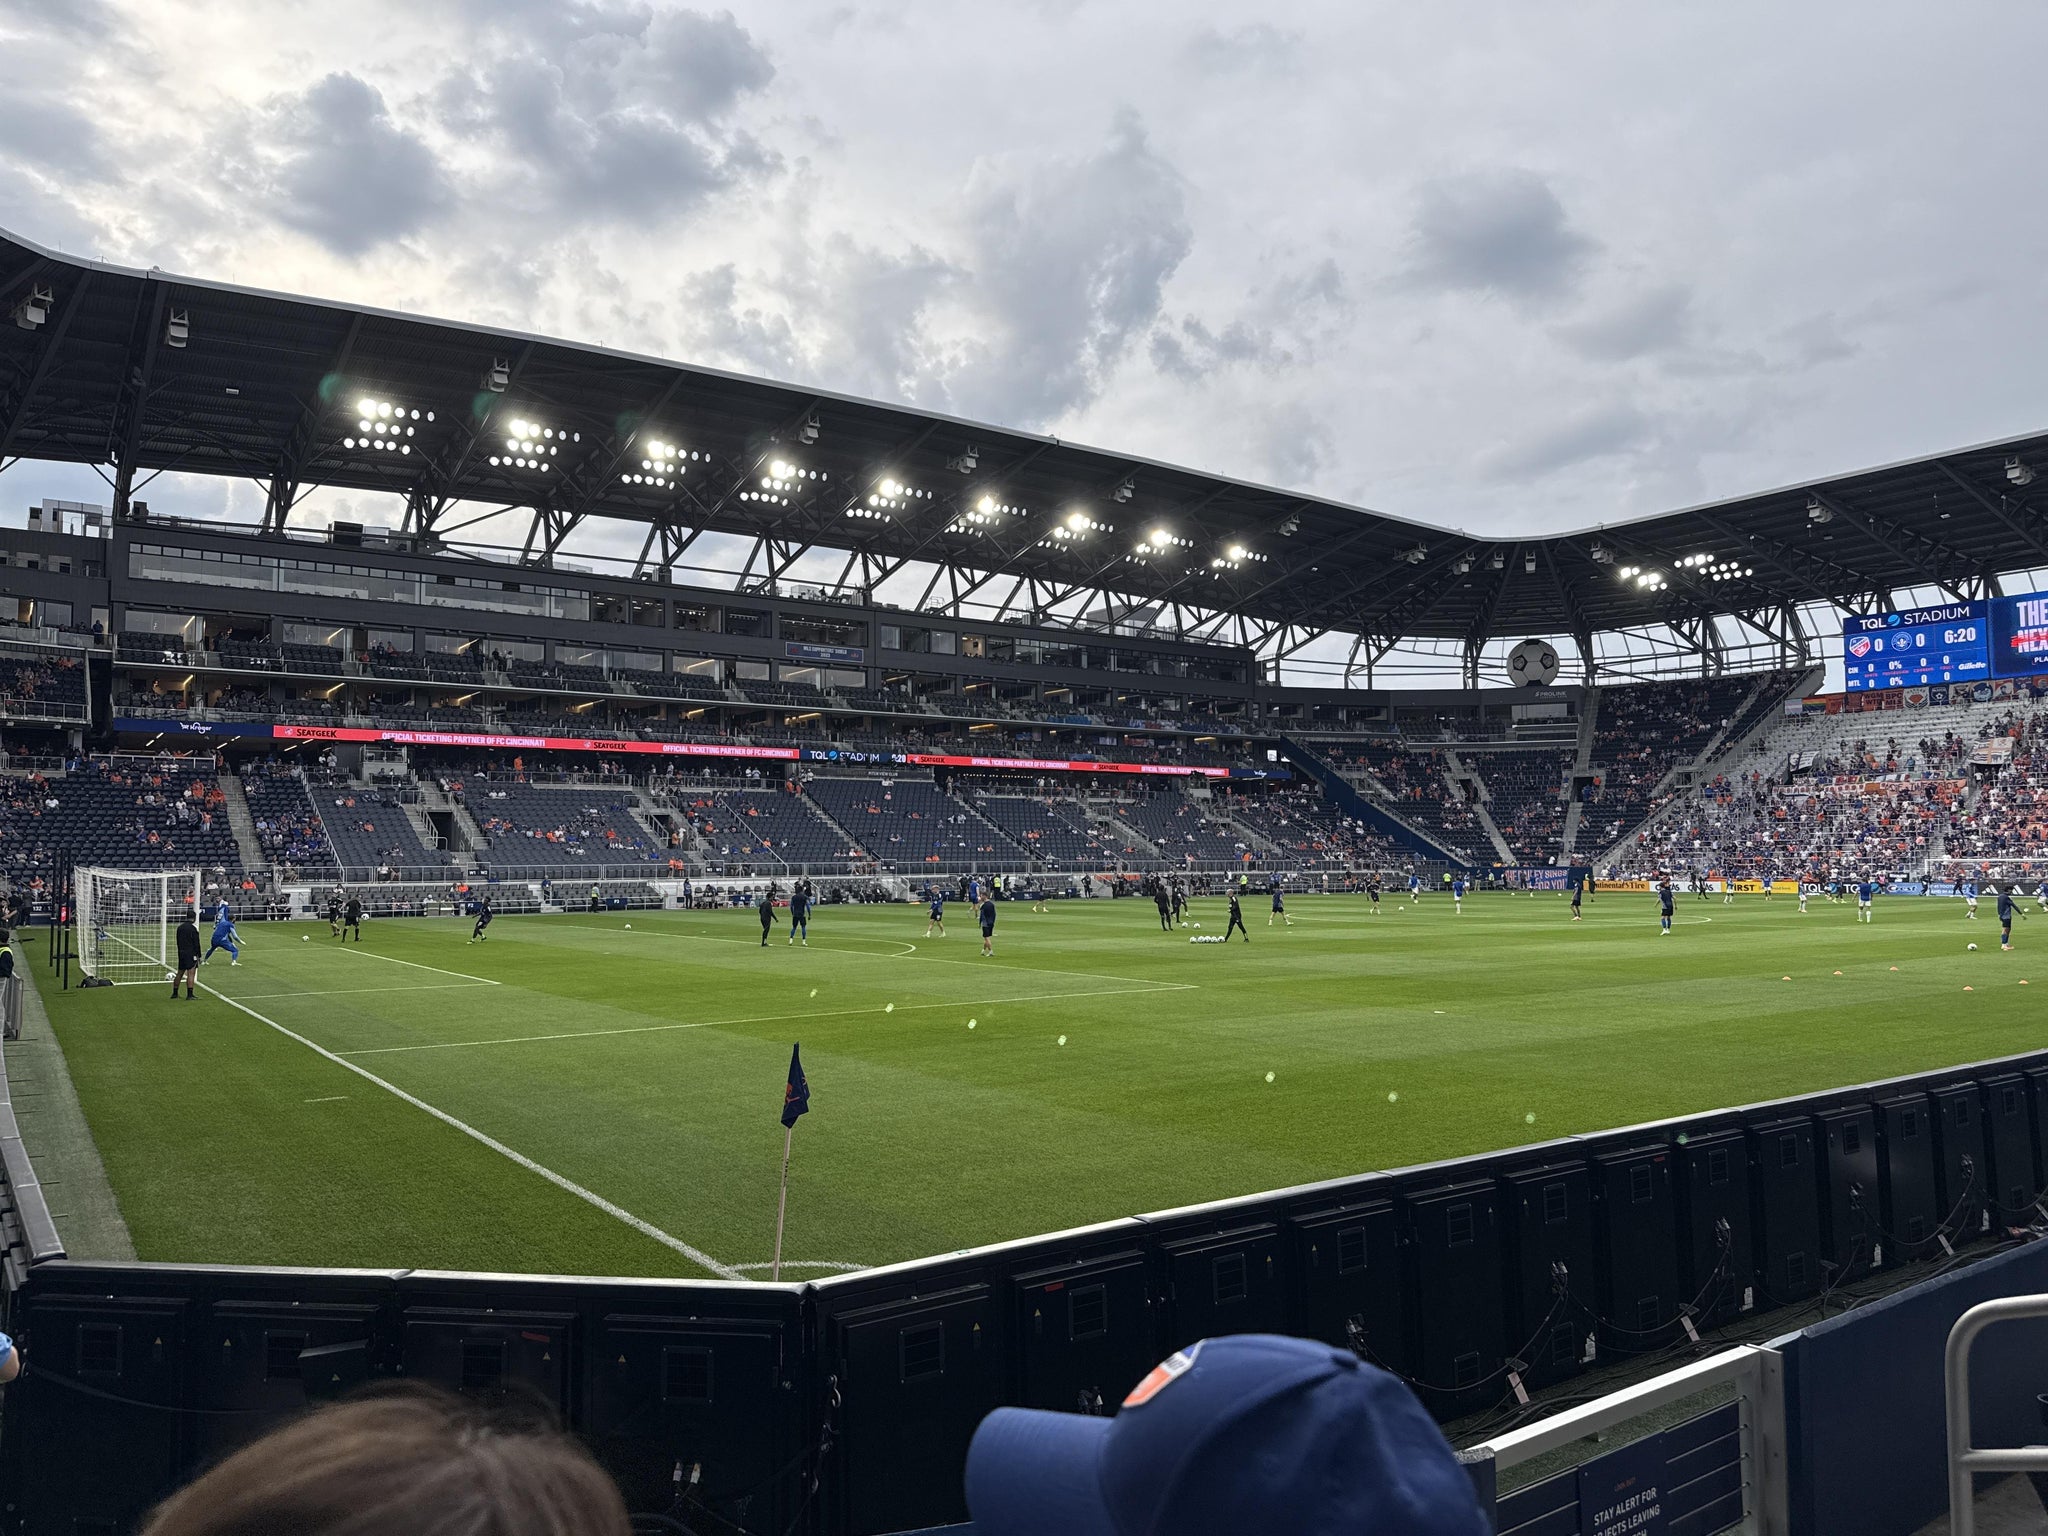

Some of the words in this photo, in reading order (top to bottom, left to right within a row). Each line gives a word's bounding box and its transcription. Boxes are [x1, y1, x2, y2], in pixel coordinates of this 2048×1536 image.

[1860, 618, 1887, 630] TQL
[1904, 606, 1970, 624] STADIUM
[2016, 599, 2048, 627] THE
[1915, 633, 1925, 647] 0
[1944, 627, 1976, 644] 6:20
[1874, 638, 1883, 652] 0
[1889, 661, 1902, 670] 0%
[1920, 658, 1927, 667] 0
[1889, 676, 1903, 686] 0%
[1921, 674, 1927, 684] 0
[1943, 671, 1950, 681] 0
[190, 722, 212, 734] Kroger
[382, 732, 415, 741] OFFICIAL
[415, 733, 452, 743] TICKETING
[453, 735, 486, 744] PARTNER
[486, 737, 496, 745] OF
[505, 738, 546, 747] CINCINNATI
[662, 744, 689, 753] OFFICIAL
[810, 751, 828, 760] TQL
[1544, 869, 1568, 879] SINGS
[1594, 880, 1625, 889] ntinental
[1630, 880, 1646, 889] Tire
[1803, 883, 1825, 893] TQL
[1594, 1506, 1614, 1526] STAY
[1615, 1494, 1640, 1516] ALERT
[1641, 1487, 1657, 1504] FOR
[1628, 1504, 1660, 1529] LEAVING
